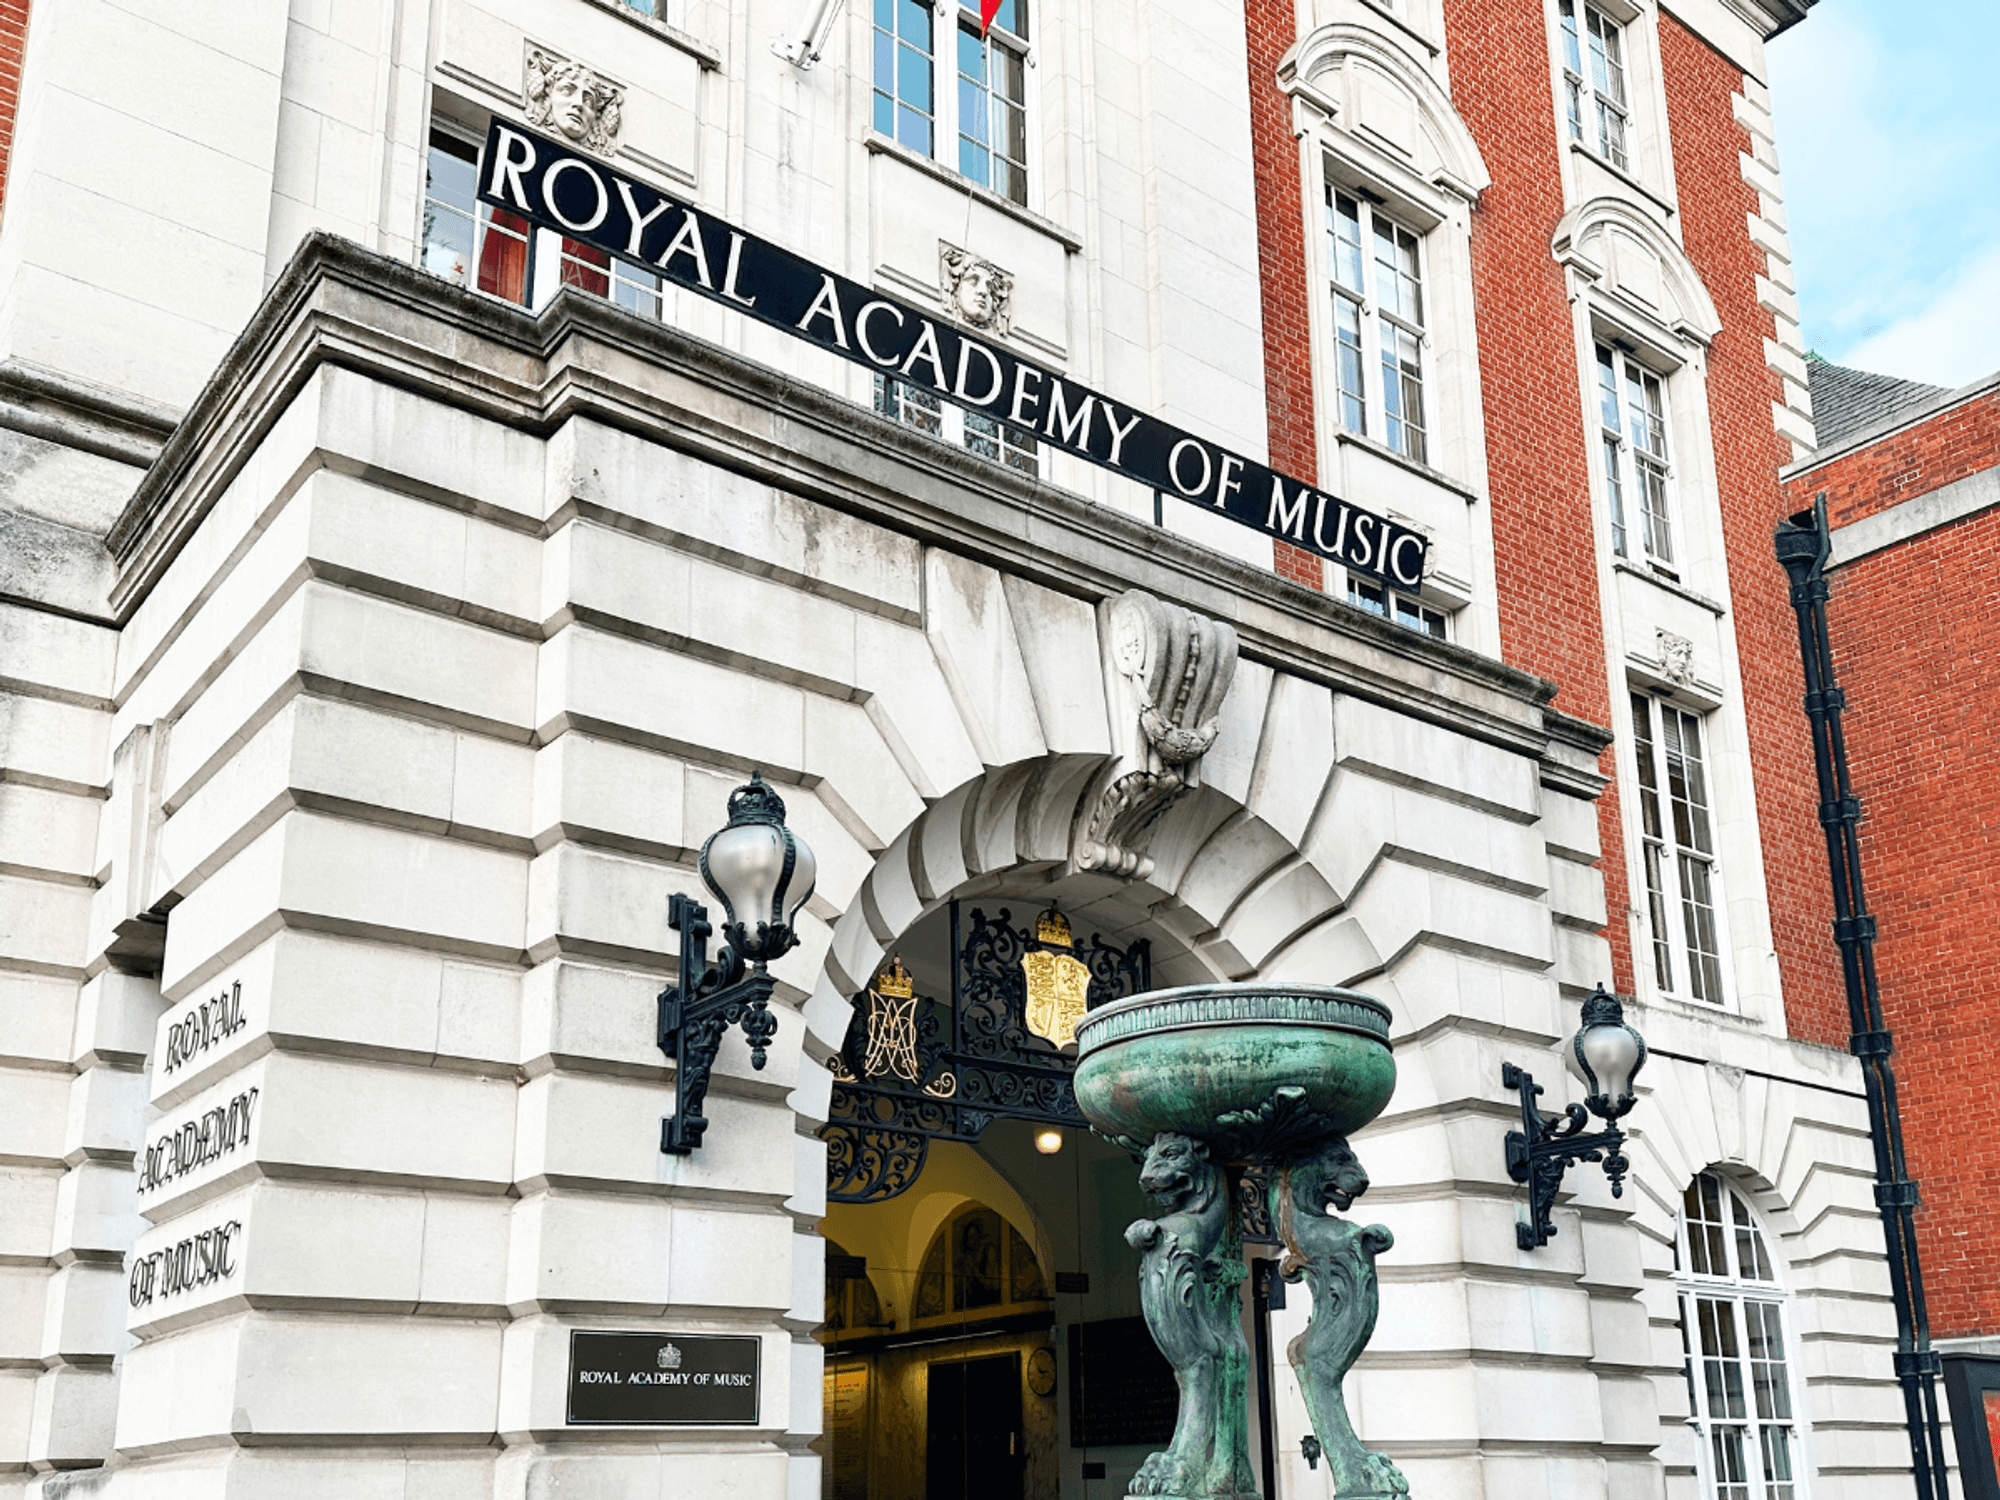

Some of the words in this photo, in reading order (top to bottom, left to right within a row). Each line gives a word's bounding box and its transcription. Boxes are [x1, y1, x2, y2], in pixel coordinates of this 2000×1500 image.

[486, 125, 756, 307] ROYAL
[796, 273, 1143, 467] ACADEMY
[1168, 438, 1245, 510] OF
[1265, 475, 1423, 586] MUSIC
[164, 979, 247, 1074] ROYAL
[137, 1086, 259, 1195] ACADEMY
[129, 1250, 163, 1308] OF
[159, 1220, 242, 1300] MUSIC
[579, 1370, 622, 1384] ROYAL
[627, 1371, 691, 1386] ACADEMY
[693, 1373, 711, 1385] OF
[713, 1373, 752, 1387] MUSIC
